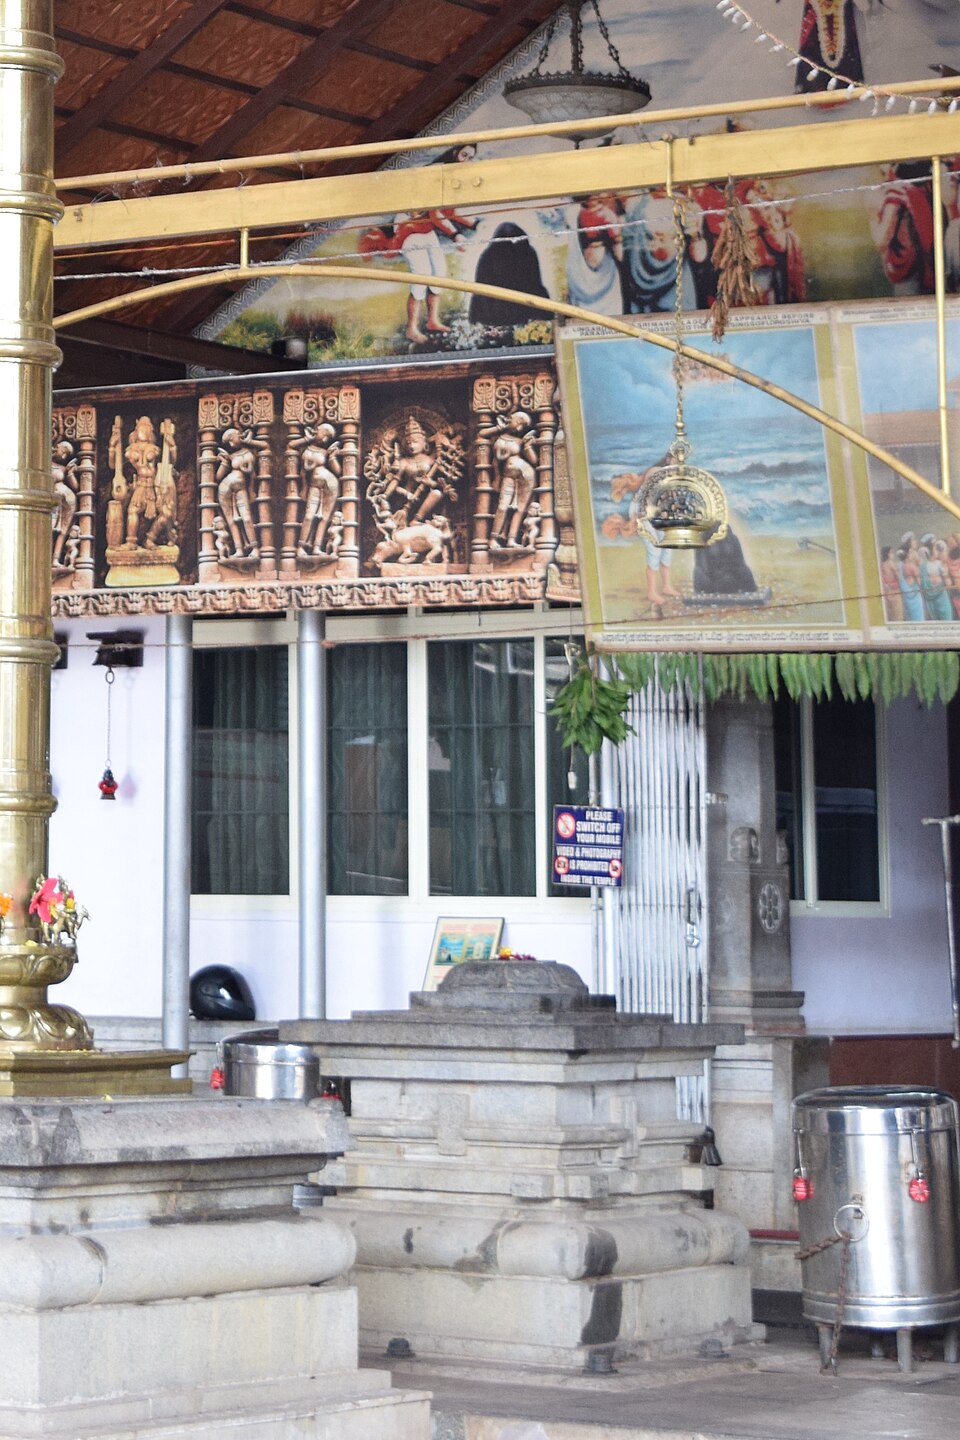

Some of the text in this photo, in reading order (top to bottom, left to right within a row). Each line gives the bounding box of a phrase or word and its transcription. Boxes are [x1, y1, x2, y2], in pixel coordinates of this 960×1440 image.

[585, 811, 613, 821] PLEASE
[576, 821, 621, 834] SWITCH OFF
[576, 833, 621, 845] YOUR MOBILE
[556, 846, 575, 857] VIDEO
[569, 859, 576, 870] IS
[581, 876, 593, 885] THE
[594, 876, 617, 886] TEMPLE
